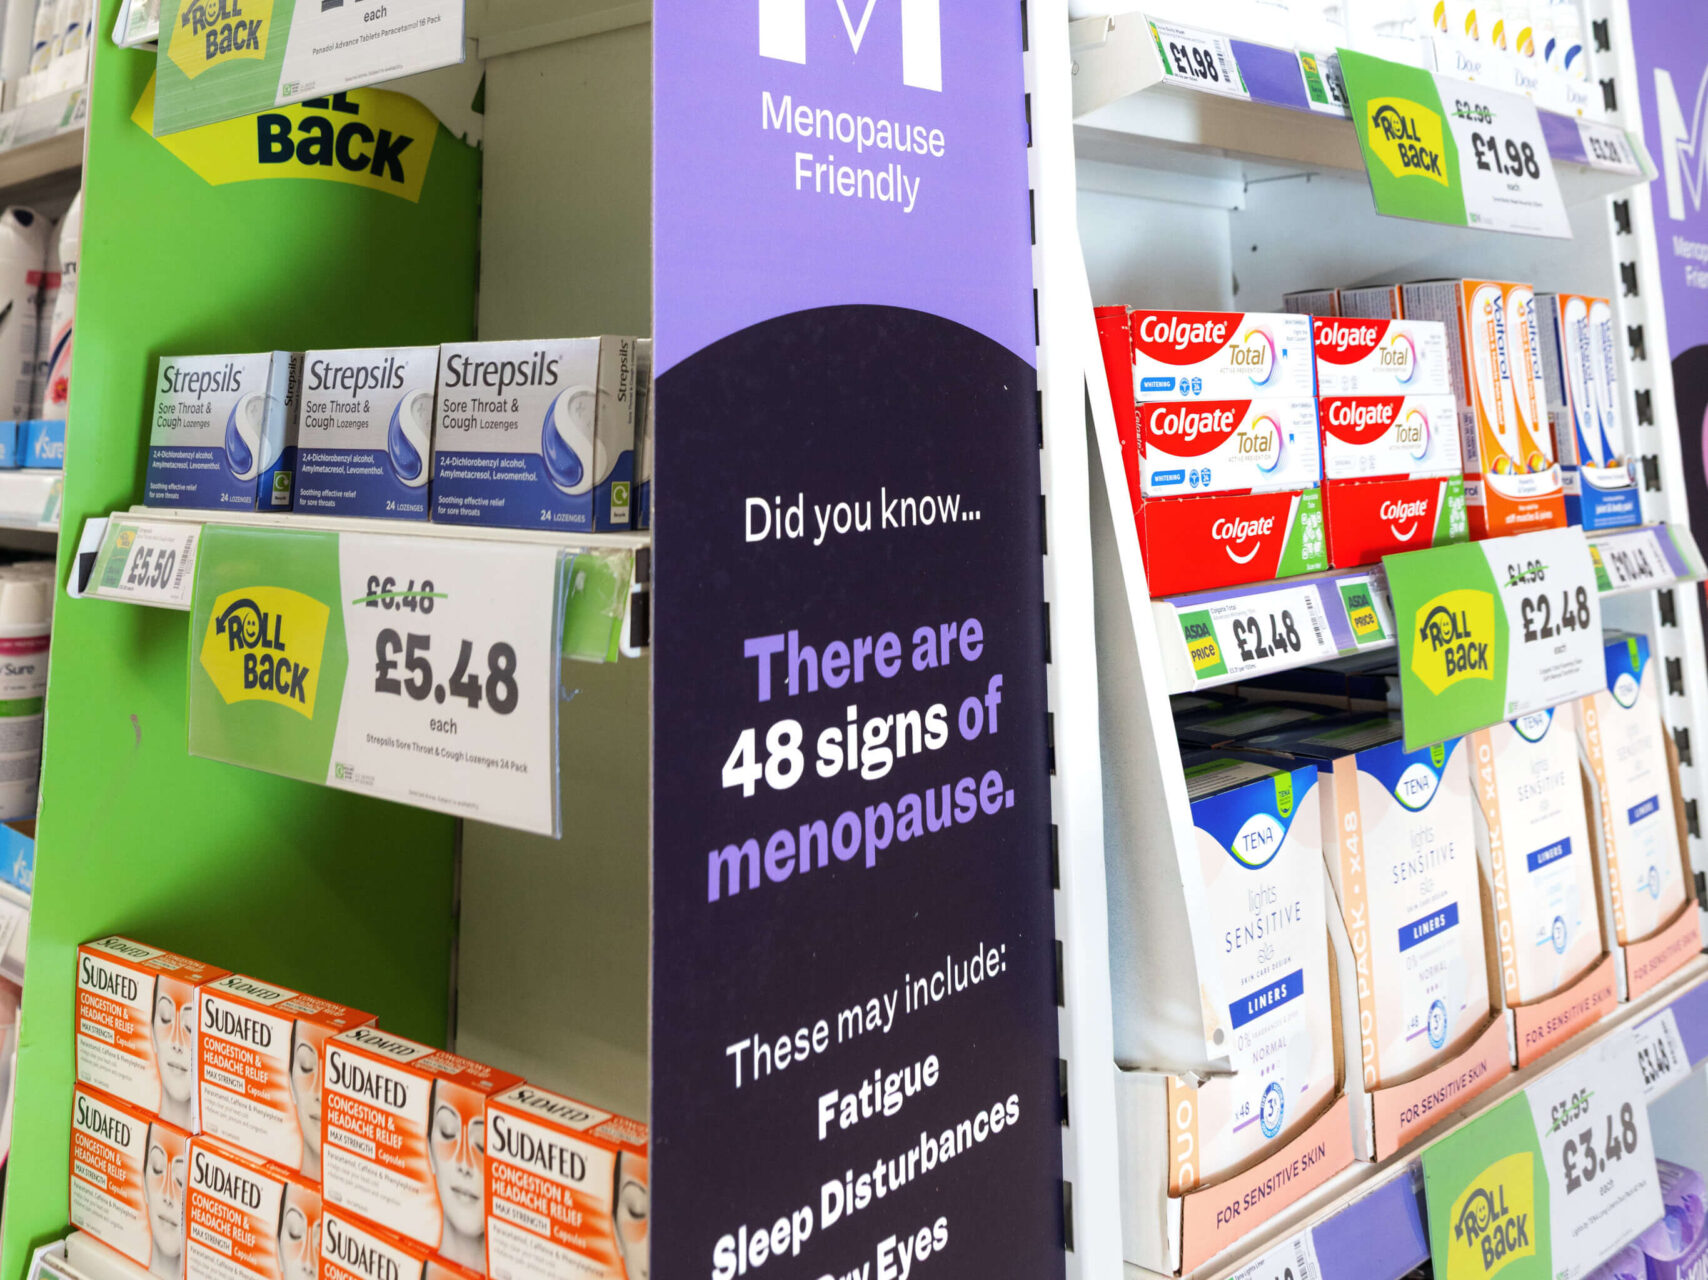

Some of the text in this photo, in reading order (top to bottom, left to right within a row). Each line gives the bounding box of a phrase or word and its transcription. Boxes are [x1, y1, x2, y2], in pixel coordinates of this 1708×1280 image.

[363, 5, 387, 23] each
[312, 14, 441, 56] Panadol Advance Tablets Paracetamol 16 Pack
[1169, 41, 1219, 83] £1.98
[761, 91, 946, 158] Menopause
[1383, 115, 1422, 143] ROLL
[1455, 99, 1493, 125] £2.98
[1471, 132, 1541, 180] £1.98
[794, 152, 921, 213] Friendly
[1140, 316, 1227, 350] Colgate
[1492, 294, 1510, 380] Voltarol
[445, 351, 559, 396] Strepsils
[1229, 344, 1266, 366] Total
[1378, 347, 1408, 366] Total
[161, 363, 242, 401] Strepsils
[308, 357, 406, 398] Strepsils
[157, 416, 211, 430] Cough Lozenges
[305, 415, 369, 431] Cough Lozenges
[306, 400, 370, 413] Sore Throat &
[442, 415, 519, 431] Cough Lozenges
[443, 398, 519, 413] Sore Throat &
[1150, 407, 1235, 441] Colgate
[1328, 400, 1394, 429] Colgate
[1237, 431, 1273, 454] Total
[1395, 422, 1422, 443] Total
[440, 456, 526, 469] 2,4-Dichlorobenzyl alcohol,
[440, 469, 538, 482] Amylmetacresol, Levomenthol.
[1154, 474, 1181, 482] WHITENING
[438, 495, 505, 507] Soothing effective relief
[540, 510, 586, 523] 24 LOZENGES
[745, 493, 805, 542] Did
[813, 500, 872, 546] you
[1211, 516, 1274, 543] Colgate
[127, 546, 176, 590] £5.50
[366, 575, 436, 615] £6.48
[1347, 593, 1369, 609] ASDA
[1521, 585, 1591, 643] £2.48
[227, 613, 287, 652] ROLL
[1184, 622, 1211, 641] ASDA
[1232, 610, 1302, 662] £2.48
[1429, 611, 1472, 652] ROLL
[374, 628, 519, 715] £5.48
[744, 617, 984, 703] There are
[430, 718, 458, 734] each
[721, 673, 1004, 799] 48 signs of
[366, 733, 528, 773] Strepsils Sore Throat & Cough Lozenges 24 Pack
[1403, 775, 1430, 797] TENA
[707, 769, 1016, 904] menopause.
[1242, 826, 1274, 852] TENA
[1392, 841, 1456, 885] SENSITIVE
[1248, 882, 1278, 918] lights
[1225, 900, 1302, 954] SENSITIVE
[1413, 912, 1447, 941] LINERS
[1343, 811, 1378, 1089] DUO PACK x48
[82, 956, 138, 1001] SUDAFED
[725, 941, 1007, 1089] These may include:
[1248, 984, 1288, 1015] LINERS
[204, 998, 272, 1048] SUDAFED
[203, 1050, 269, 1084] HEADACHE RELIEF
[1253, 1036, 1288, 1064] NORMAL
[1638, 1036, 1671, 1086] £3.48
[329, 1051, 408, 1109] SUDAFED
[817, 1054, 940, 1141] Fatigue
[1400, 1060, 1488, 1128] FOR SENSITIVE SKIN
[77, 1095, 131, 1148] SUDAFED
[327, 1109, 404, 1150] HEADACHE RELIEF
[1550, 1086, 1590, 1133] £3.95
[492, 1114, 587, 1183] SUDAFED
[1562, 1101, 1638, 1196] £3.48
[193, 1151, 262, 1210] SUDAFED
[491, 1162, 573, 1206] CONGESTION &
[711, 1205, 814, 1280] Sleep
[820, 1093, 1021, 1231] Disturbances
[1216, 1142, 1327, 1229] FOR SENSITIVE SKIN
[491, 1181, 584, 1228] HEADACHE RELIEF
[495, 1203, 548, 1232] MAX STRENGTH
[553, 1226, 587, 1249] Capsules
[875, 1216, 949, 1280] Eyes
